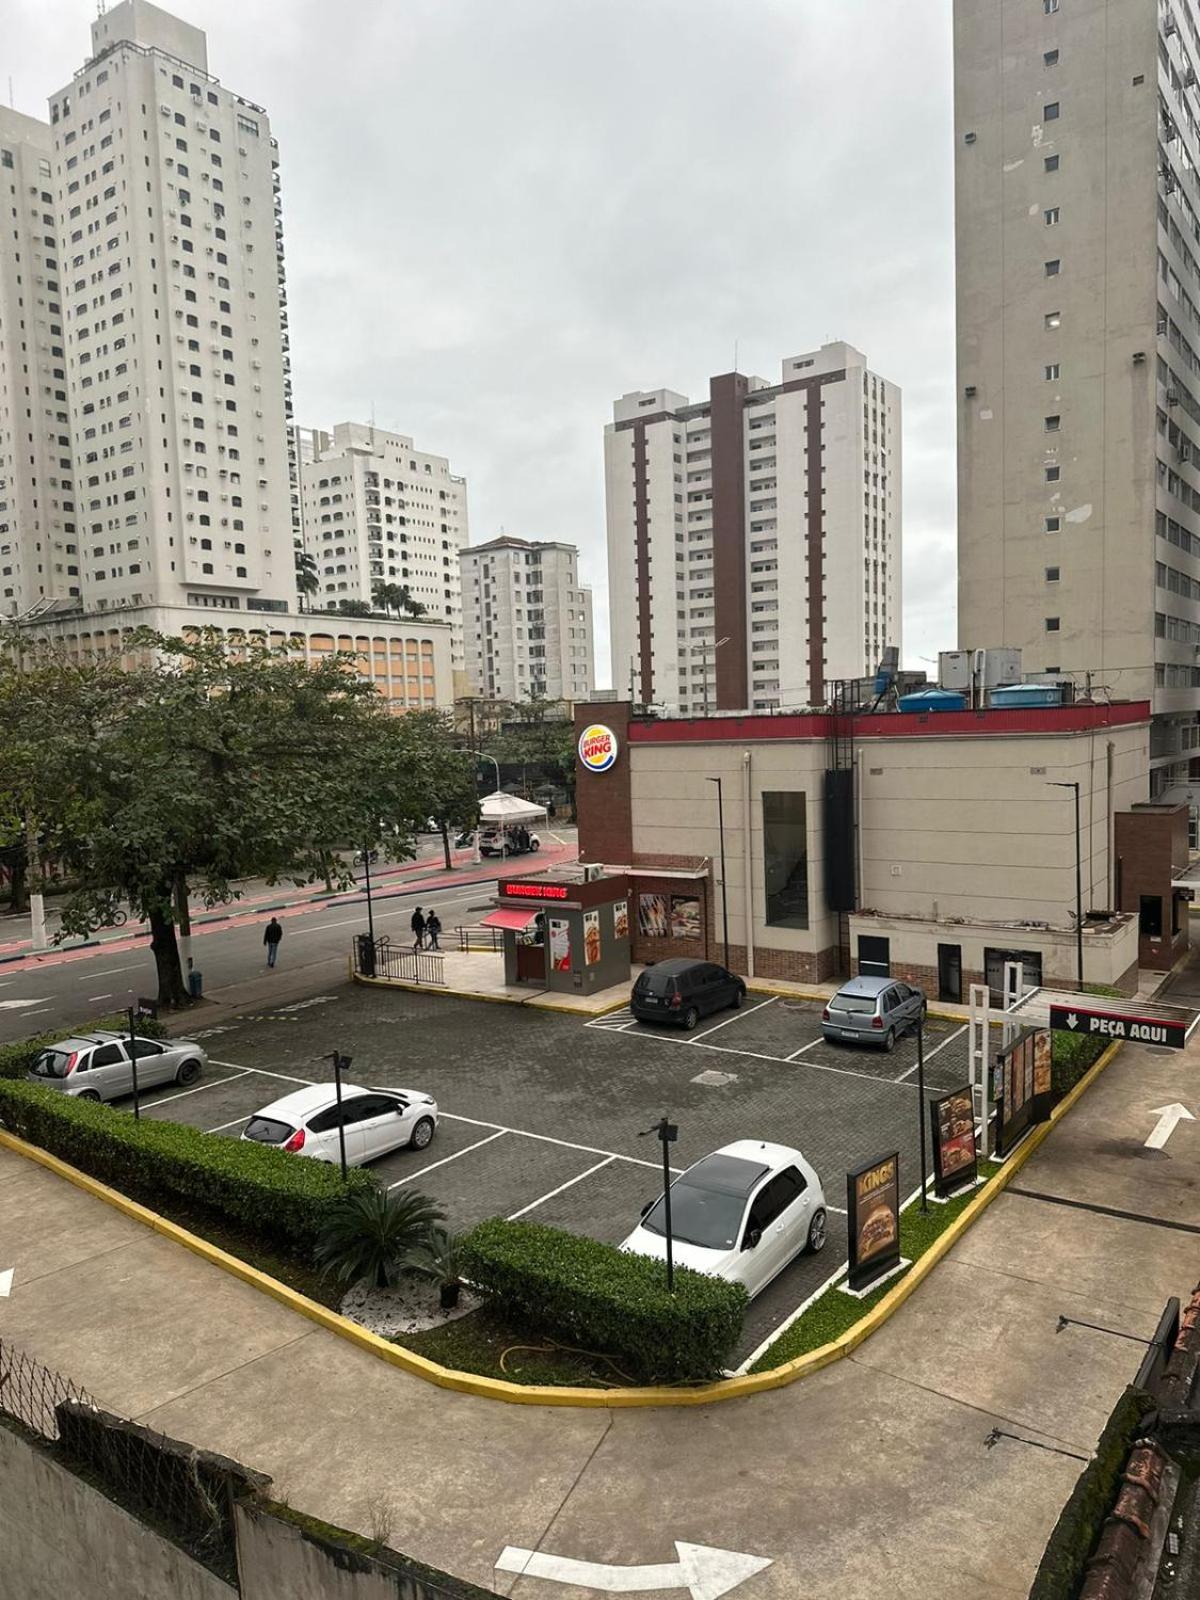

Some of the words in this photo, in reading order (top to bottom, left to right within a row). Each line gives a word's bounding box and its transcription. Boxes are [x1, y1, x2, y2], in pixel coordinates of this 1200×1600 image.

[584, 734, 610, 747] BURGER
[584, 742, 611, 758] KING
[1089, 1018, 1125, 1037] PEÇA
[1130, 1023, 1167, 1042] AQUI
